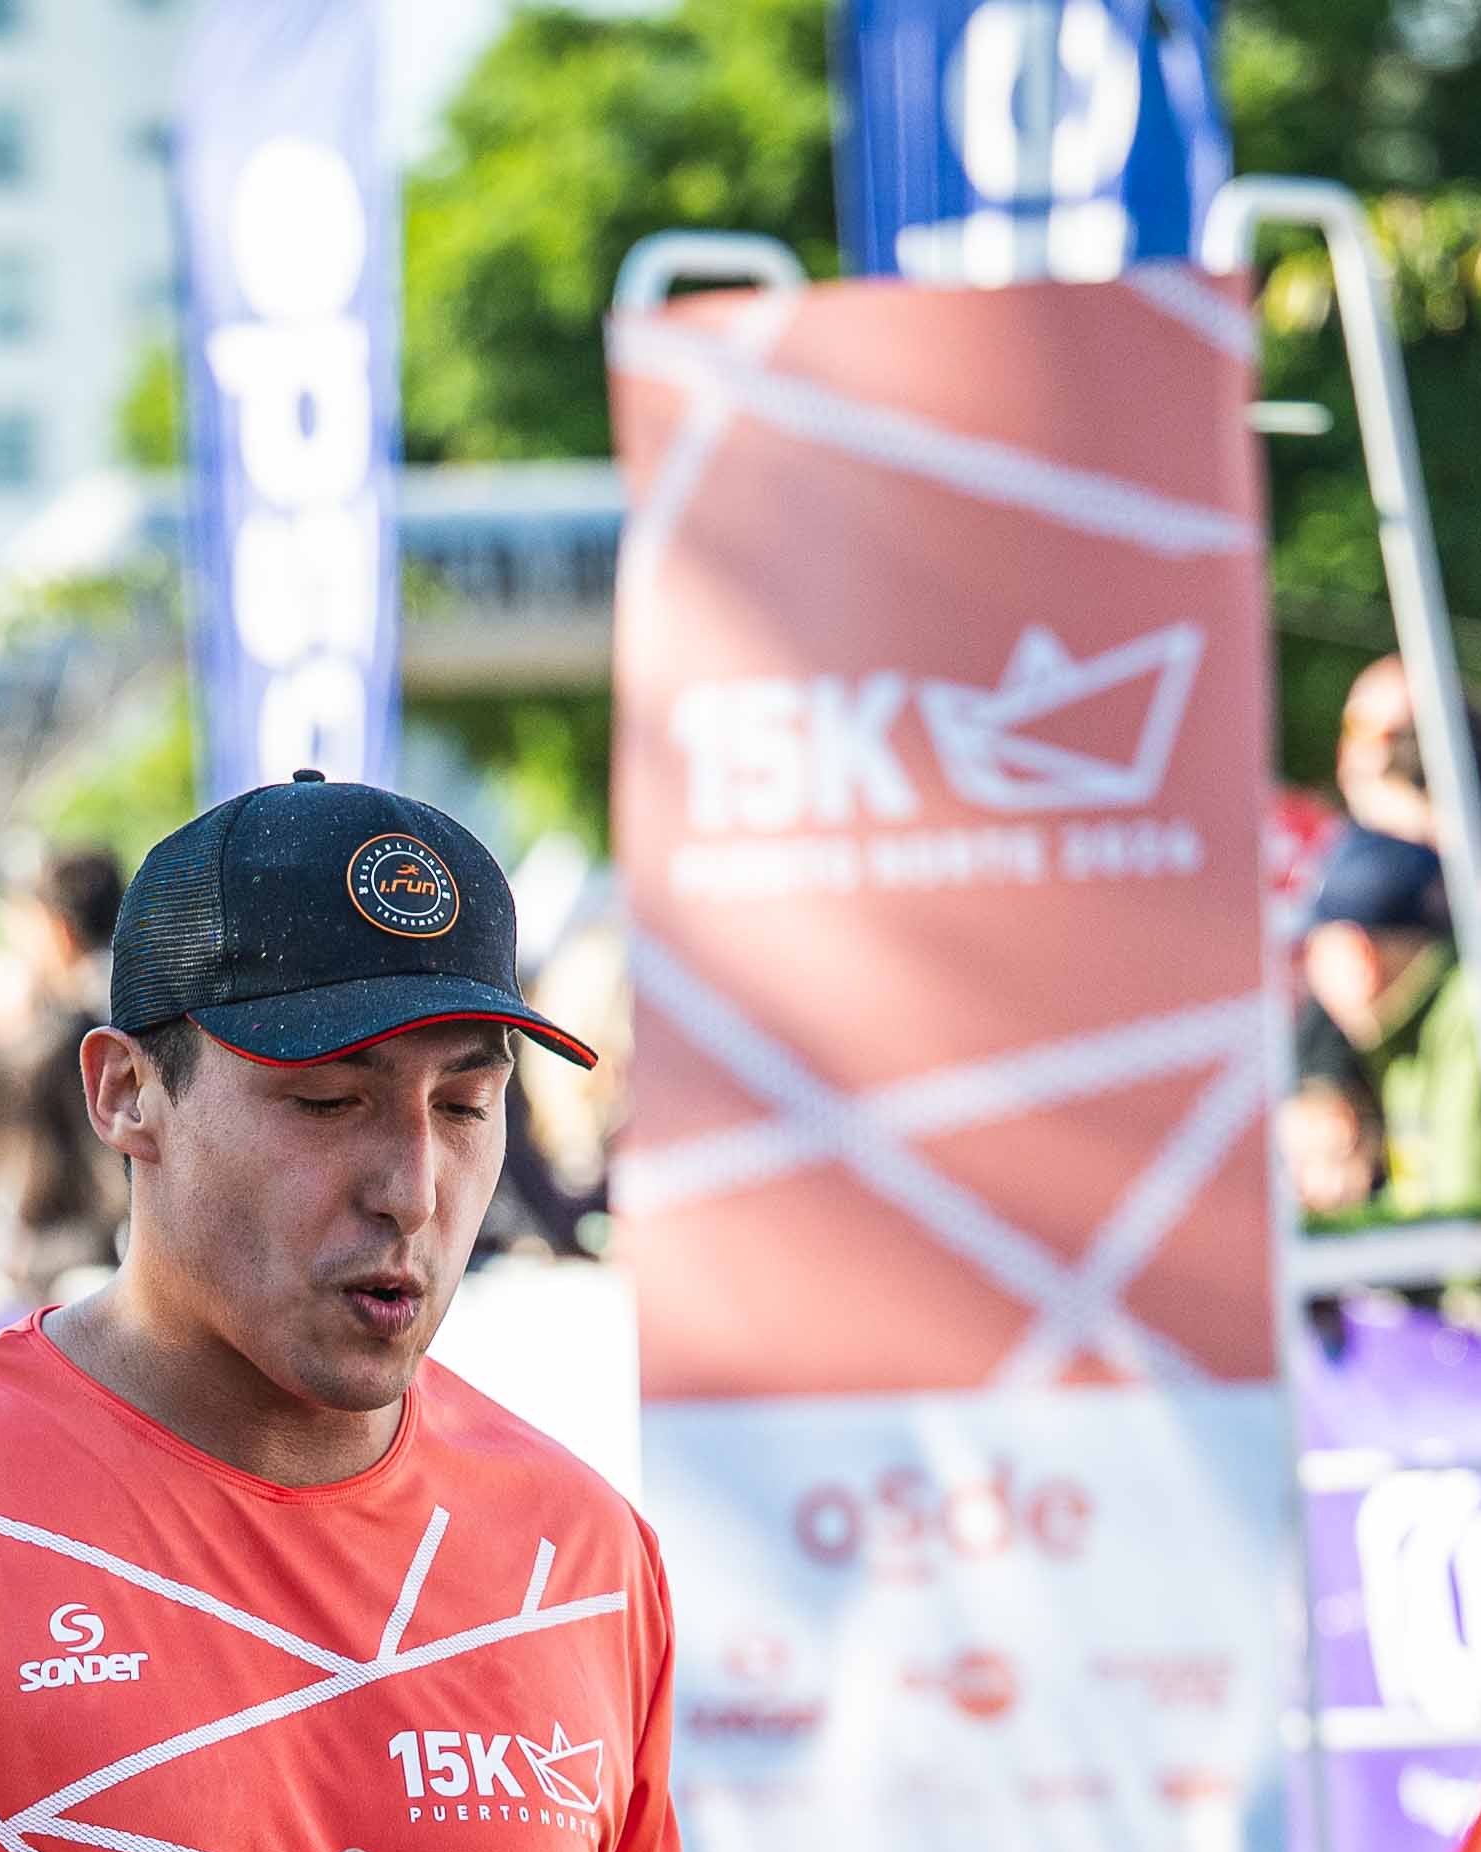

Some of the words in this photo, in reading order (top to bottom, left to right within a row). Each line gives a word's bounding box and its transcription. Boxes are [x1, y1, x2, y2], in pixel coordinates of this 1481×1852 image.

[671, 670, 920, 830] 15K
[388, 1730, 526, 1798] 15K
[408, 1805, 530, 1823] PUERTO
[540, 1808, 596, 1840] NORTE
